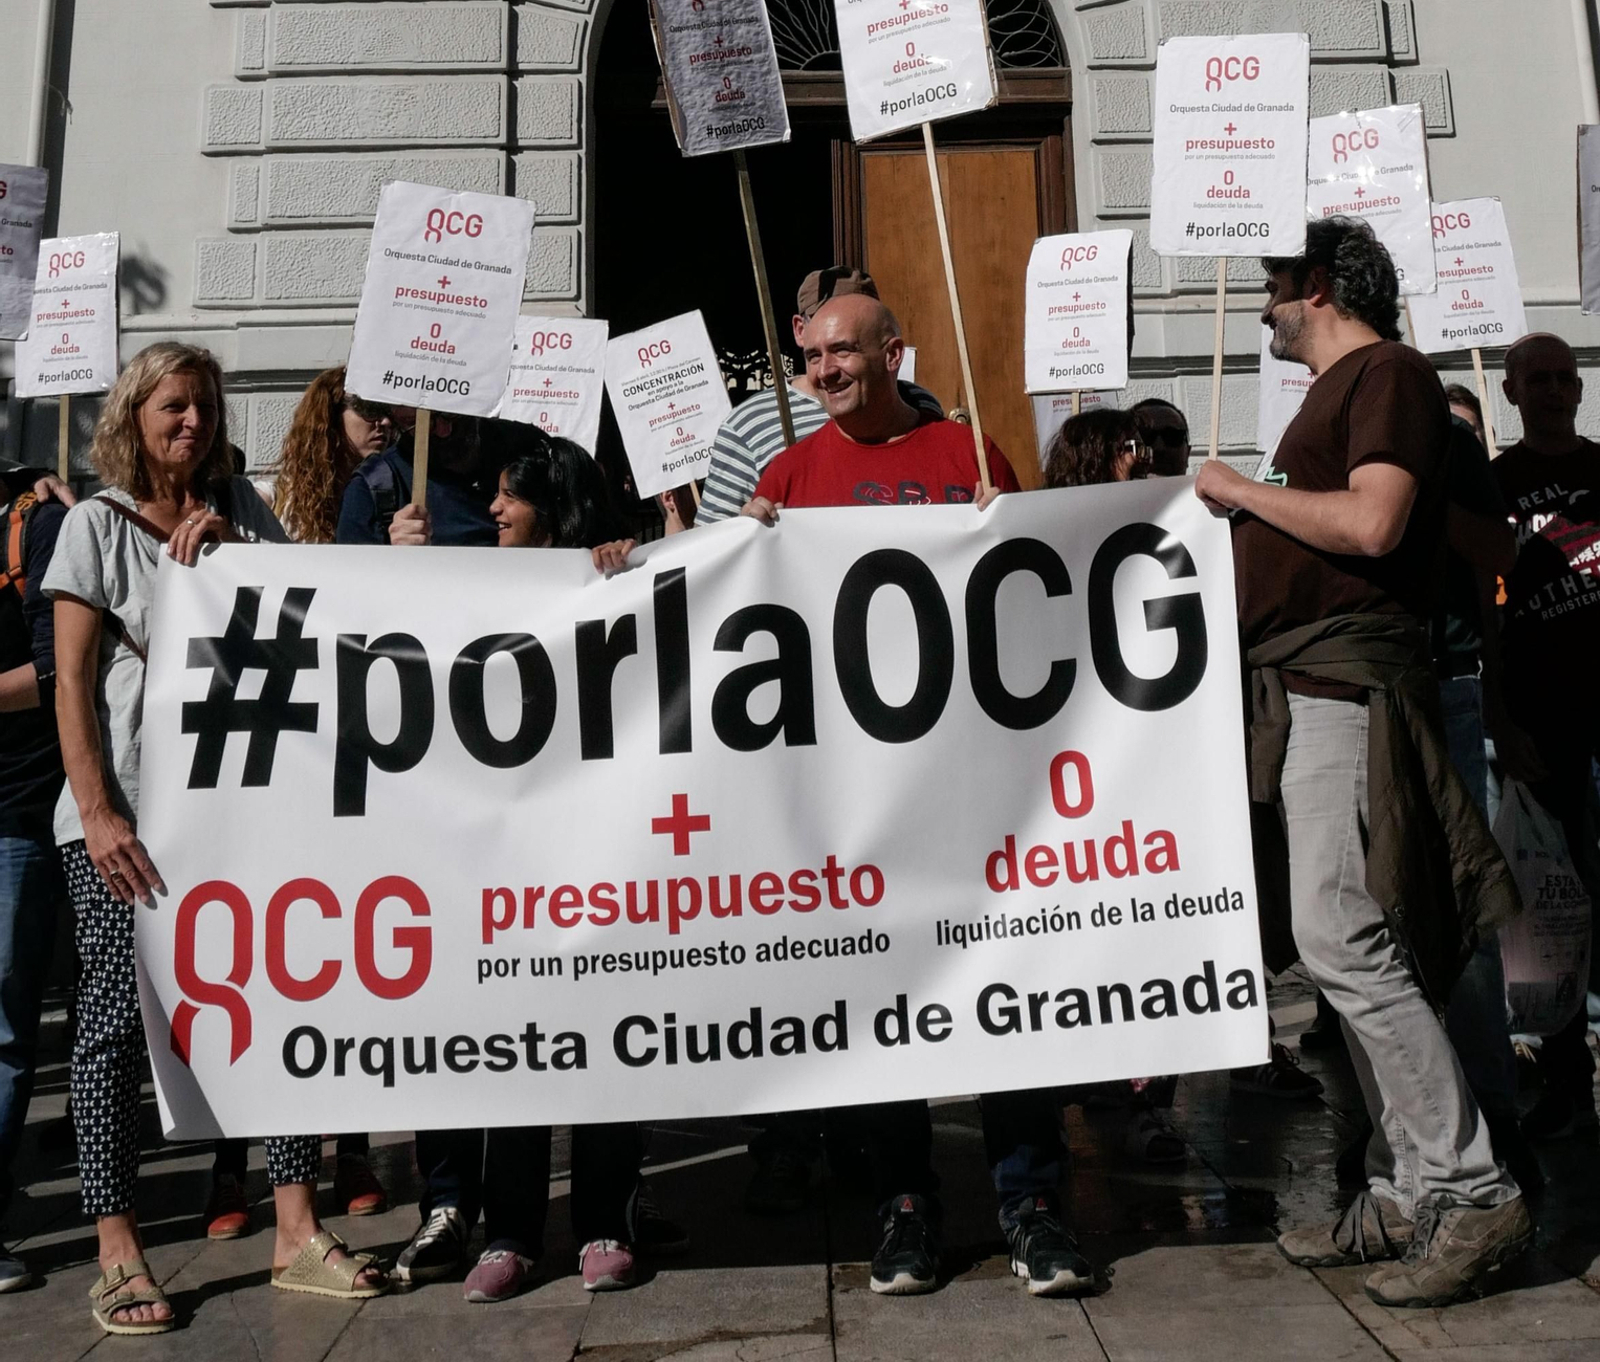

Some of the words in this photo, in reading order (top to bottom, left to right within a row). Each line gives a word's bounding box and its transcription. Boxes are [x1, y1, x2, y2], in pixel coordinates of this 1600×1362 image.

[867, 2, 949, 36] presupuesto
[689, 46, 752, 65] presupuesto
[906, 42, 915, 57] 0
[1205, 56, 1260, 92] OCG
[715, 88, 746, 103] deuda
[880, 83, 957, 116] #porlaOCG
[1170, 104, 1210, 114] Orquesta
[1212, 103, 1243, 112] Ciudad
[1244, 103, 1255, 112] de
[1257, 103, 1294, 112] Granada
[706, 117, 765, 137] #porlaOCG
[1186, 138, 1275, 152] presupuesto
[1333, 128, 1379, 163] OCG
[1380, 163, 1413, 174] Granada
[1224, 170, 1234, 185] 0
[1206, 185, 1250, 198] deuda
[1322, 196, 1400, 217] presupuesto
[424, 208, 483, 244] OCG
[1186, 222, 1270, 239] #porlaOCG
[1442, 244, 1465, 252] Ciudad
[49, 251, 85, 278] OCG
[384, 247, 426, 262] Orquesta
[427, 254, 460, 268] Ciudad
[460, 259, 472, 269] de
[474, 261, 512, 275] Granada
[1061, 245, 1098, 271] OCG
[1437, 266, 1493, 278] resupuesto
[52, 285, 74, 293] Ciudad
[83, 282, 107, 290] Granada
[1037, 280, 1063, 288] Orquesta
[1064, 278, 1085, 286] Ciudad
[1094, 275, 1118, 283] Granada
[395, 286, 488, 308] presupuesto
[1461, 289, 1469, 300] 0
[414, 303, 454, 314] presupuesto
[455, 310, 486, 319] adecuado
[1048, 301, 1106, 316] presupuesto
[1451, 300, 1484, 311] deuda
[36, 308, 95, 323] presupuesto
[62, 333, 69, 345] 0
[430, 323, 441, 338] 0
[1073, 326, 1080, 338] 0
[1442, 322, 1504, 340] #porlaOCG
[51, 343, 80, 355] deuda
[411, 336, 455, 354] deuda
[531, 331, 572, 357] OCG
[1062, 337, 1091, 348] deuda
[638, 340, 671, 369] OCG
[38, 369, 93, 383] #porlaOCG
[535, 364, 557, 372] Ciudad
[568, 366, 595, 374] Granada
[1049, 363, 1104, 379] #porlaOCG
[382, 370, 470, 396] #porlaOCG
[623, 363, 705, 398] CONCENTRACIÓN
[513, 388, 580, 399] presupuesto
[628, 398, 655, 411] Orquesta
[655, 391, 676, 402] Ciudad
[684, 380, 709, 391] Granada
[540, 412, 548, 423] 0
[649, 404, 701, 428] presupuesto
[676, 427, 683, 436] 0
[670, 434, 696, 447] deuda
[1517, 483, 1569, 510] REAL
[181, 521, 1208, 818] #porlaOCG
[1049, 750, 1094, 819] 0
[985, 820, 1181, 893] deuda
[482, 855, 885, 945] presupuesto
[936, 905, 1082, 949] liquidación
[1090, 902, 1122, 927] de
[1131, 898, 1156, 923] la
[1164, 887, 1244, 919] deuda
[477, 957, 521, 984] por
[530, 956, 562, 978] un
[573, 941, 746, 981] presupuesto
[755, 929, 890, 963] adecuado
[171, 876, 432, 1067] OCG
[282, 1022, 587, 1087] Orquesta
[612, 1000, 850, 1069] Ciudad
[873, 993, 953, 1047] de
[976, 960, 1259, 1036] Granada
